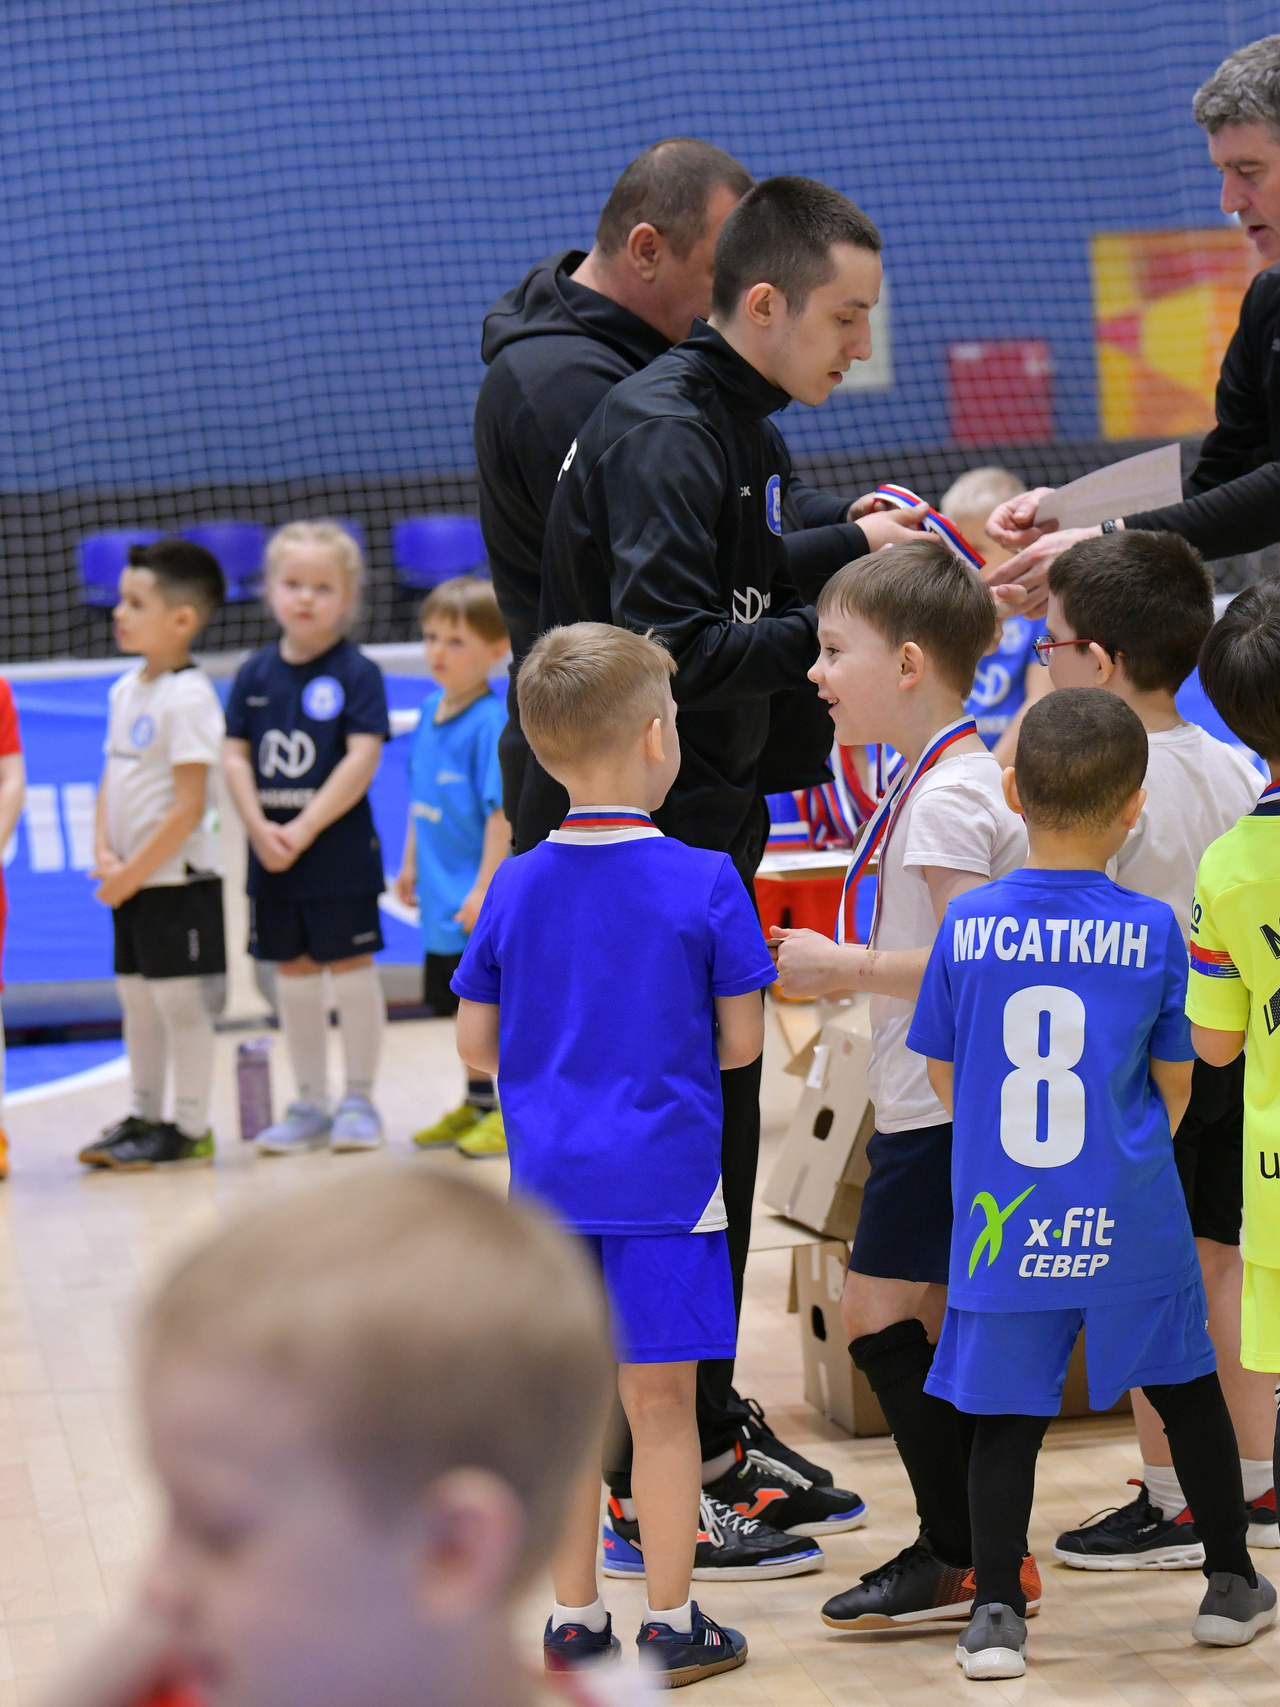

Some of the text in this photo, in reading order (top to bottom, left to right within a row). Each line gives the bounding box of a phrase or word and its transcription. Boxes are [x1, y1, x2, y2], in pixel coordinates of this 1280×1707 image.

[953, 916, 1149, 969] МУСАТКИН
[999, 985, 1086, 1169] 8
[1018, 1253, 1110, 1278] СЕВЕР
